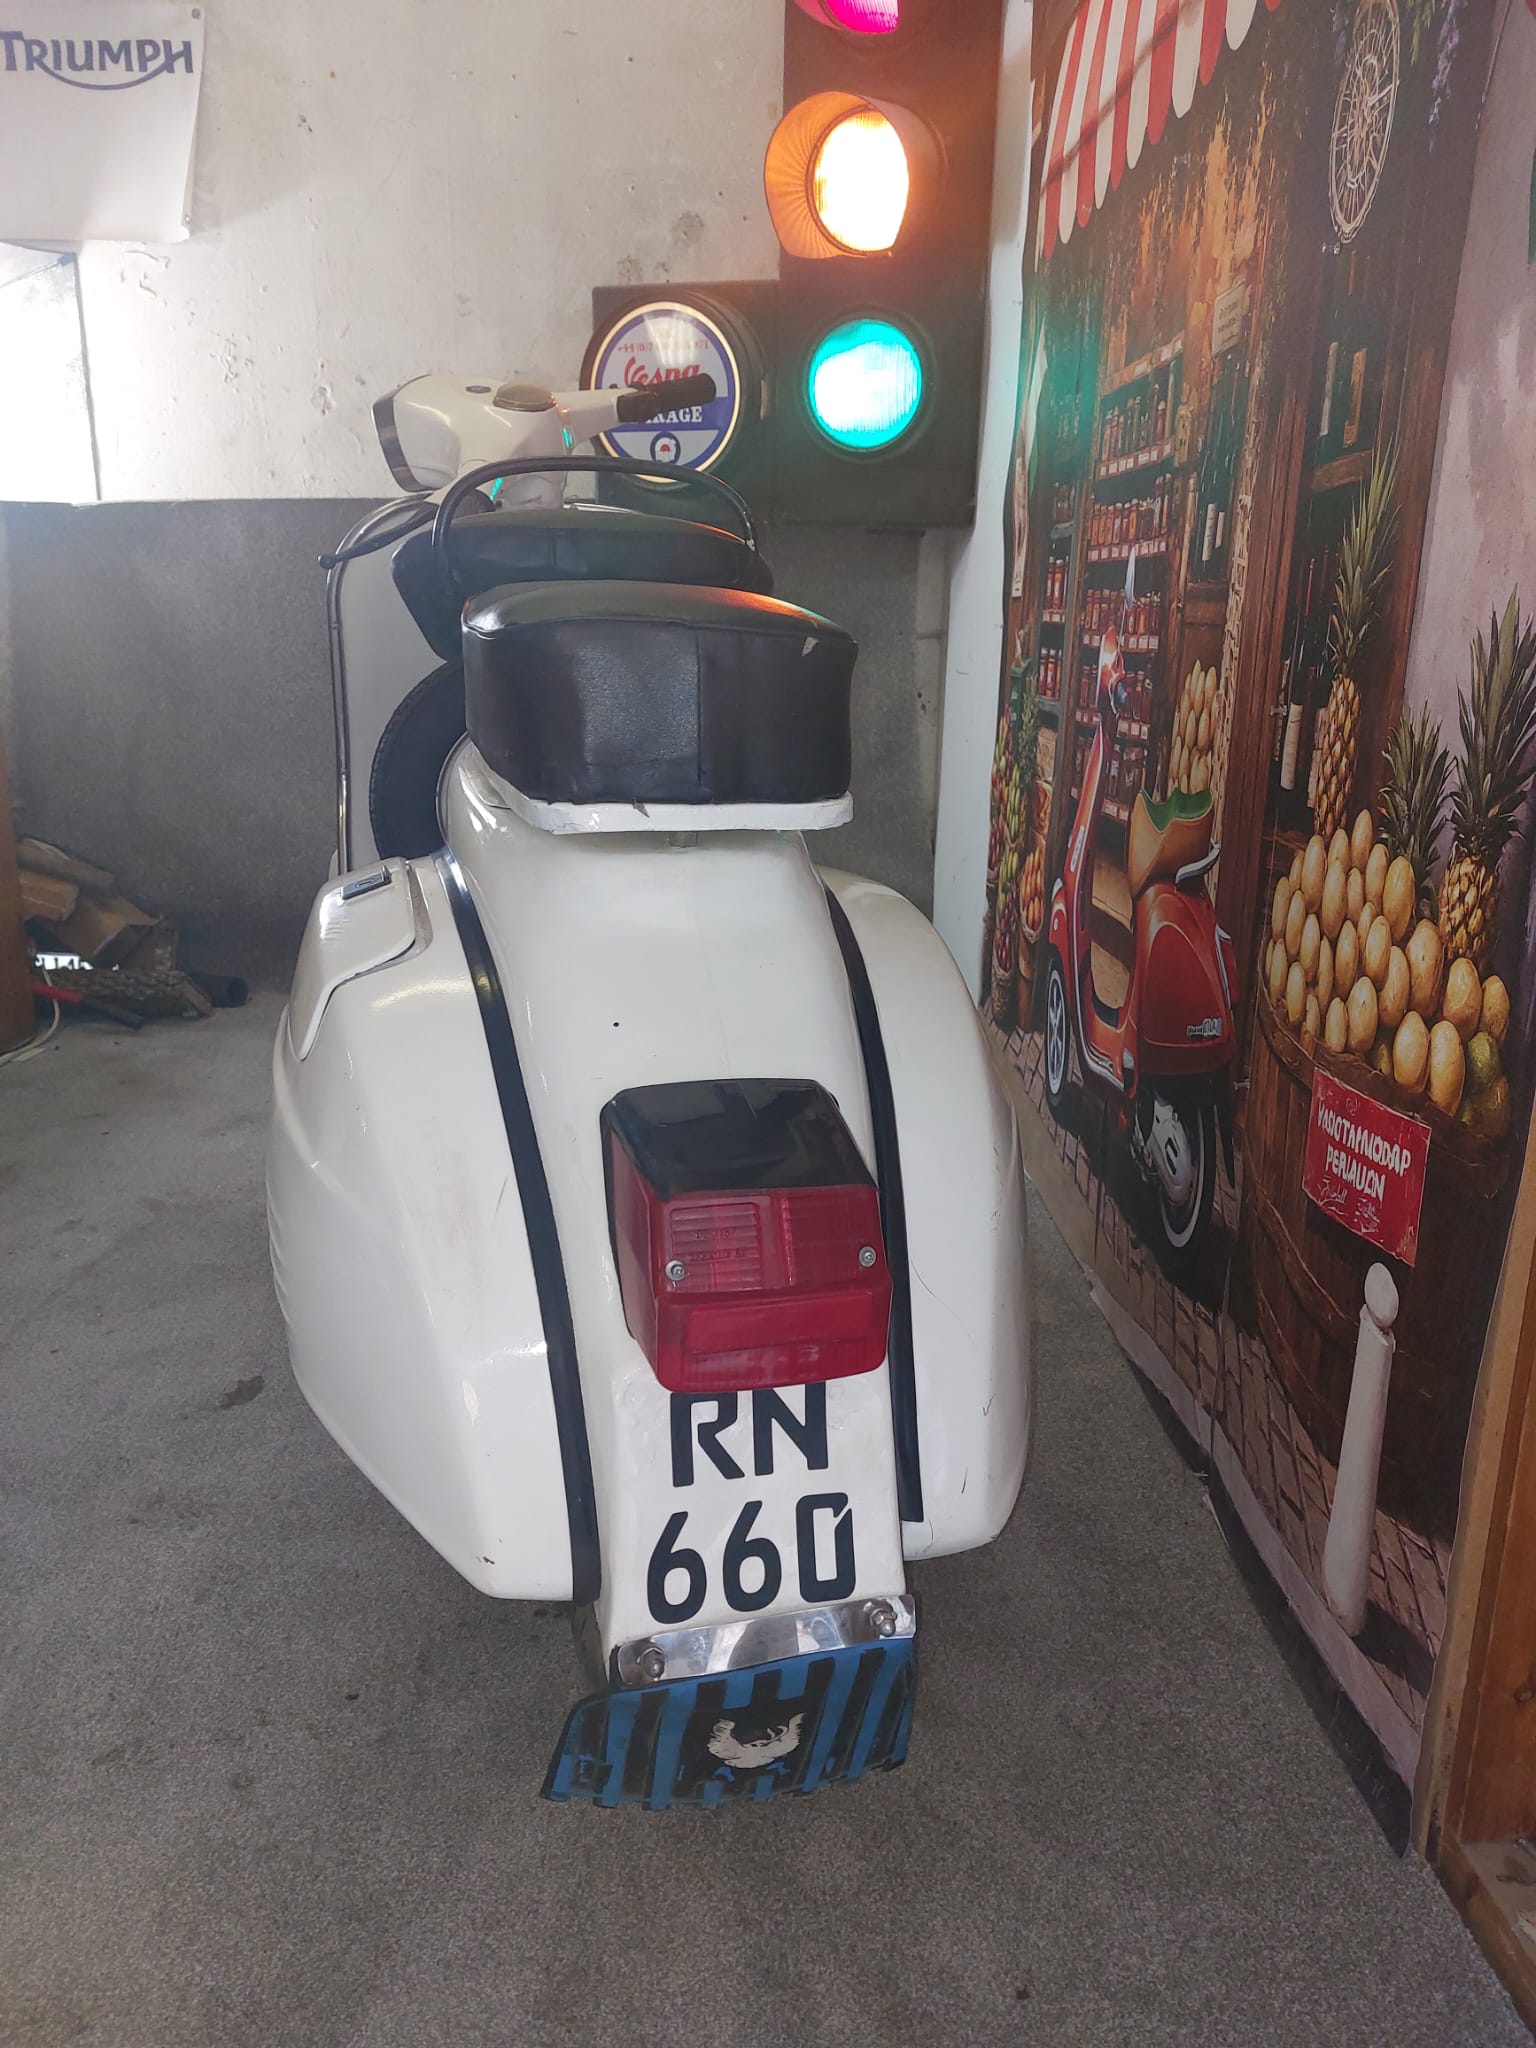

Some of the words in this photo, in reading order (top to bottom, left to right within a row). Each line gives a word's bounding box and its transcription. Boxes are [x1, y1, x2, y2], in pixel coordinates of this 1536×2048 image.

[0, 31, 194, 90] TRIUMPH
[670, 1381, 828, 1488] RN
[646, 1492, 857, 1625] 660
